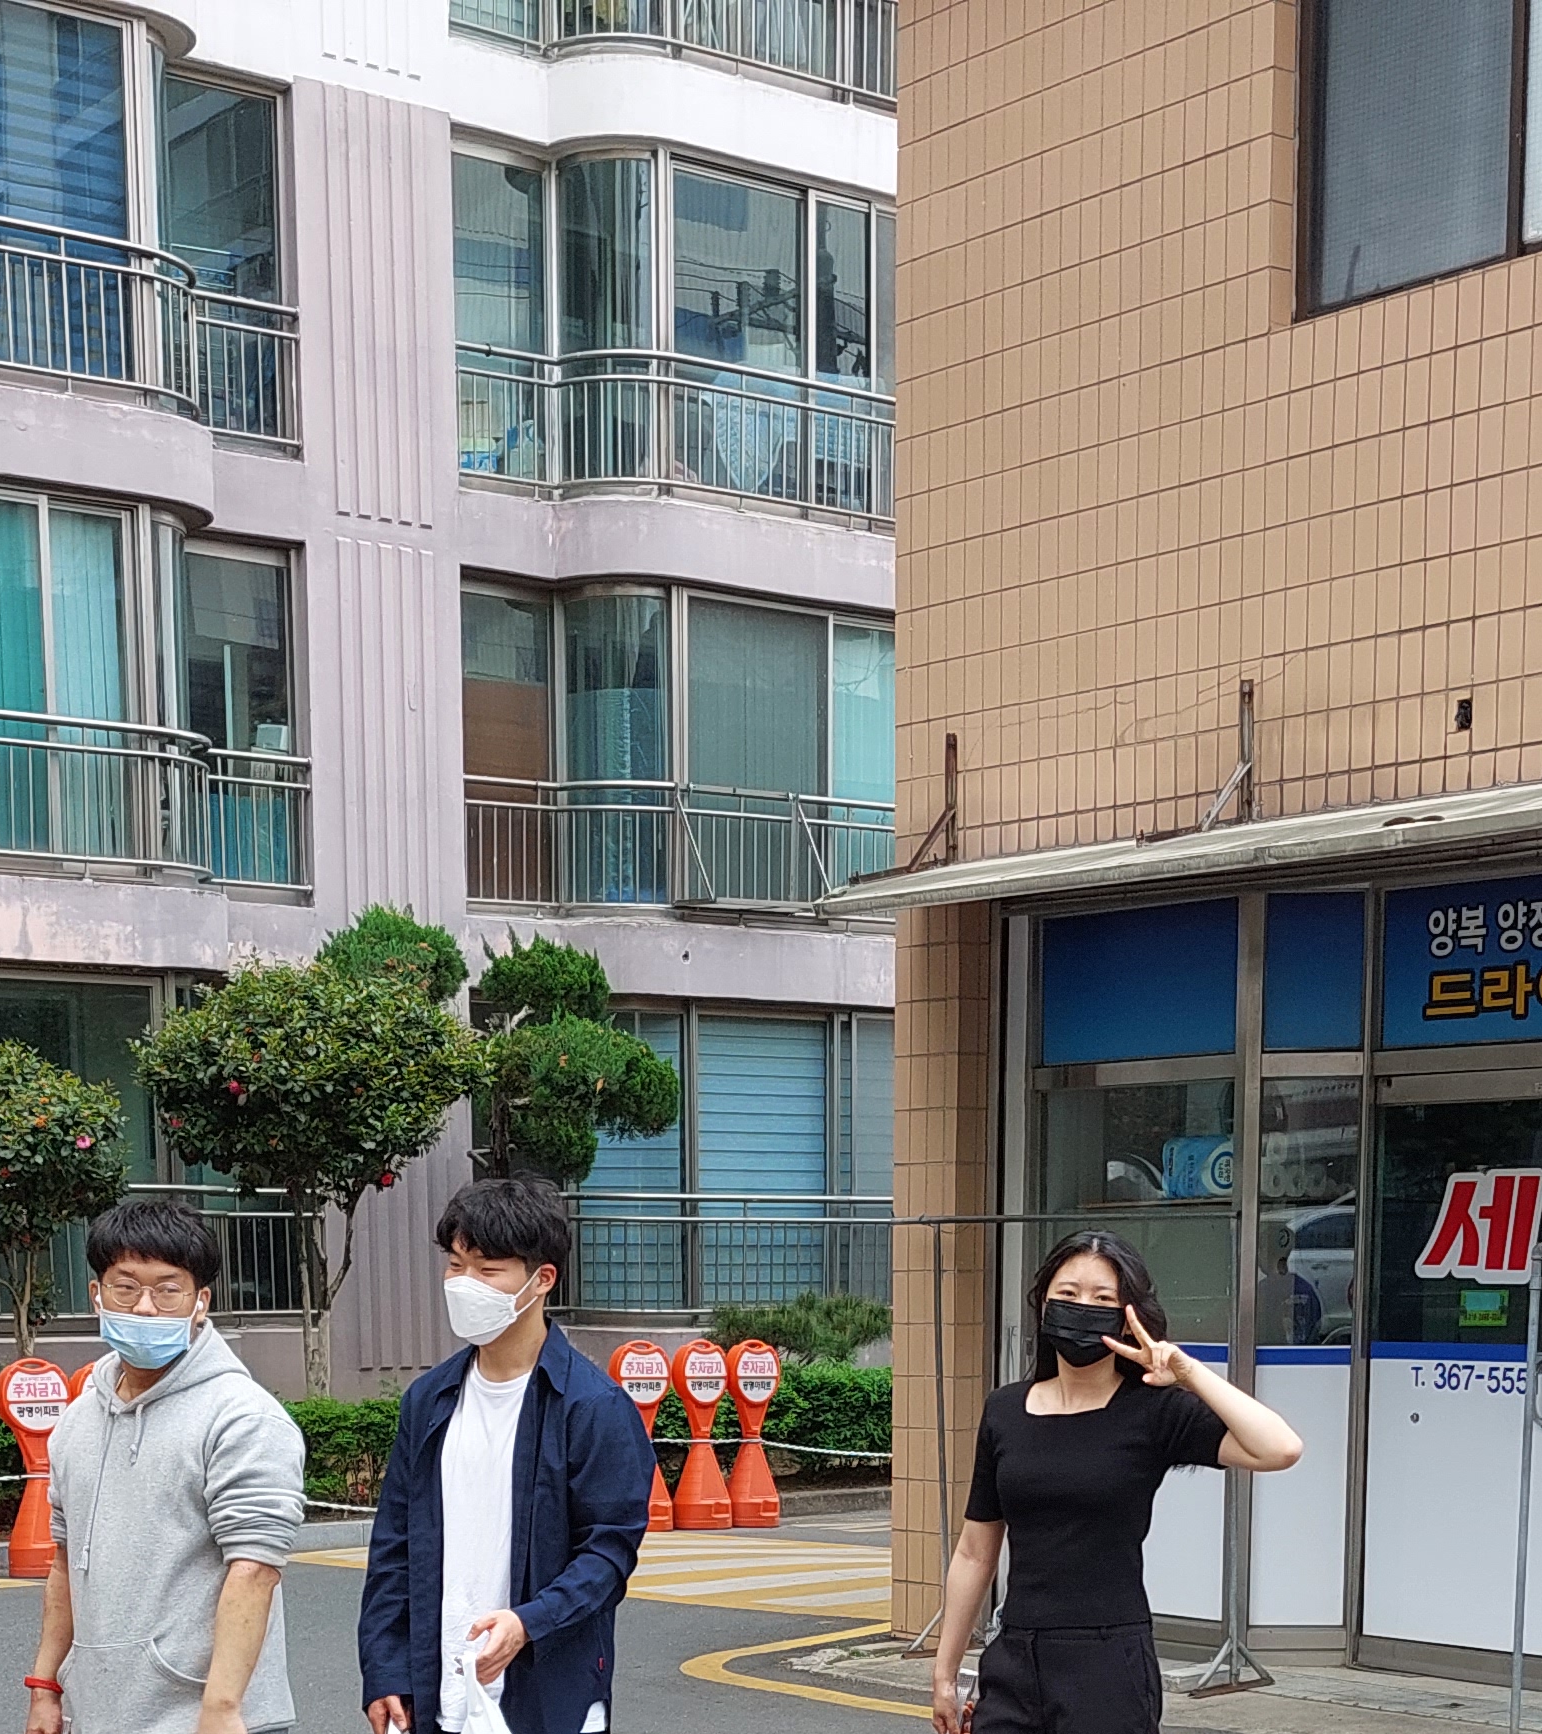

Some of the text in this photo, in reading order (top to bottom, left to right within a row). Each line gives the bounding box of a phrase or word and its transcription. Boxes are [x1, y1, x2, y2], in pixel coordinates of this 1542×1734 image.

[1428, 903, 1486, 957] 양복
[12, 1381, 62, 1398] 주차금지
[1433, 1362, 1527, 1394] 367-555
